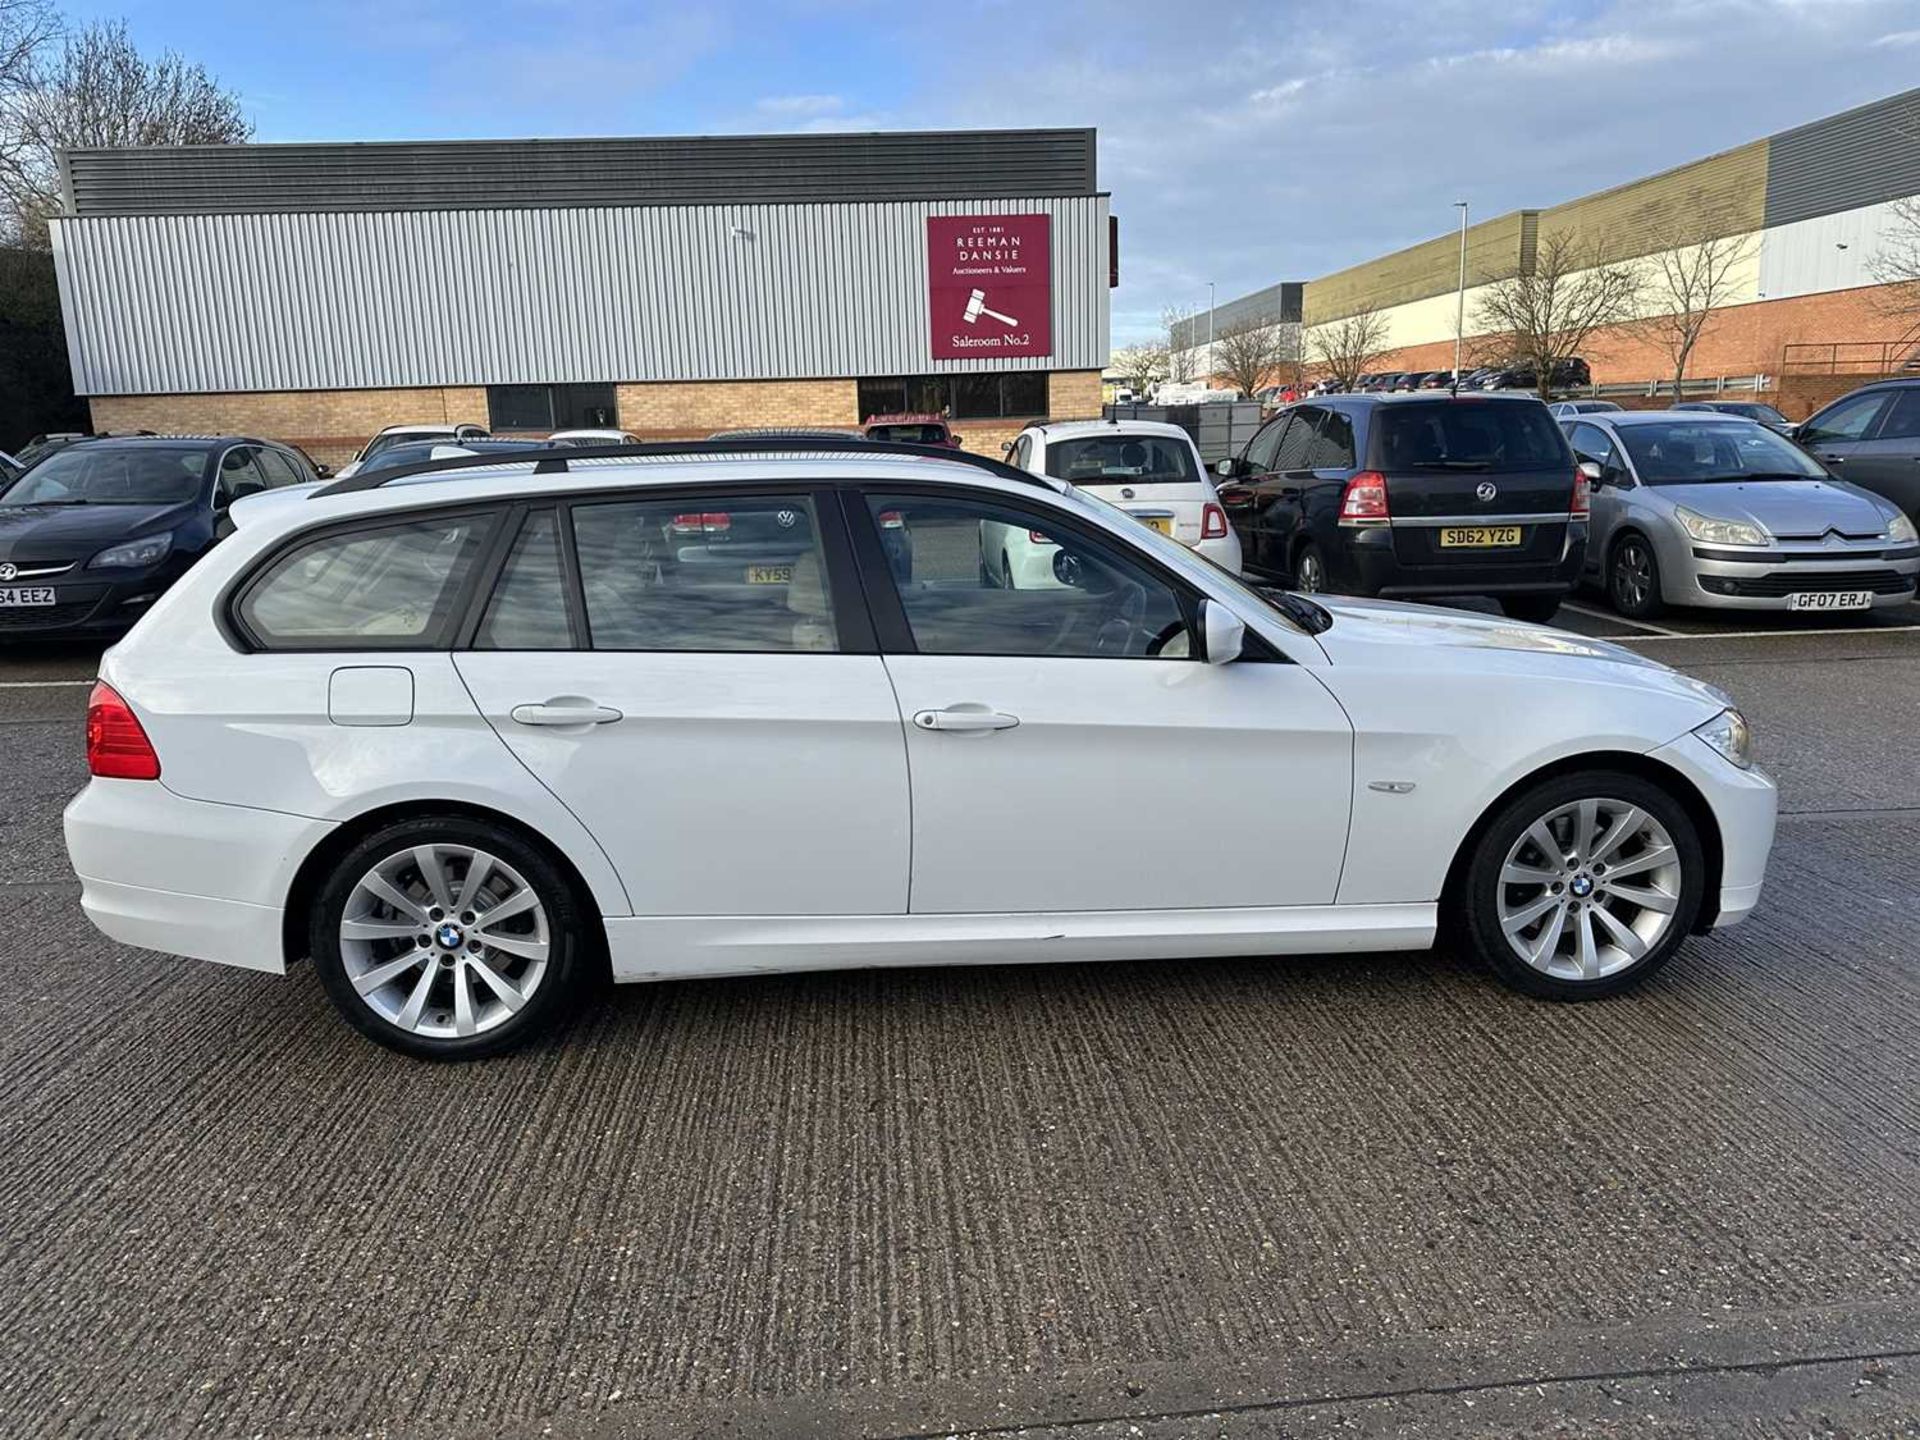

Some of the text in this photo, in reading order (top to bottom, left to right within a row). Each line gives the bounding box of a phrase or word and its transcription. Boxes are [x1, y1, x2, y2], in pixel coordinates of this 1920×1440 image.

[956, 236, 1021, 248] REEMAN
[959, 250, 1019, 261] DANSIE
[952, 265, 1027, 275] Auctioneers & Valuers
[952, 333, 1030, 347] Saleroom No.2
[1447, 528, 1515, 543] SD62 YZG
[20, 588, 53, 603] EEZ
[1797, 593, 1867, 607] GF07 ERJ
